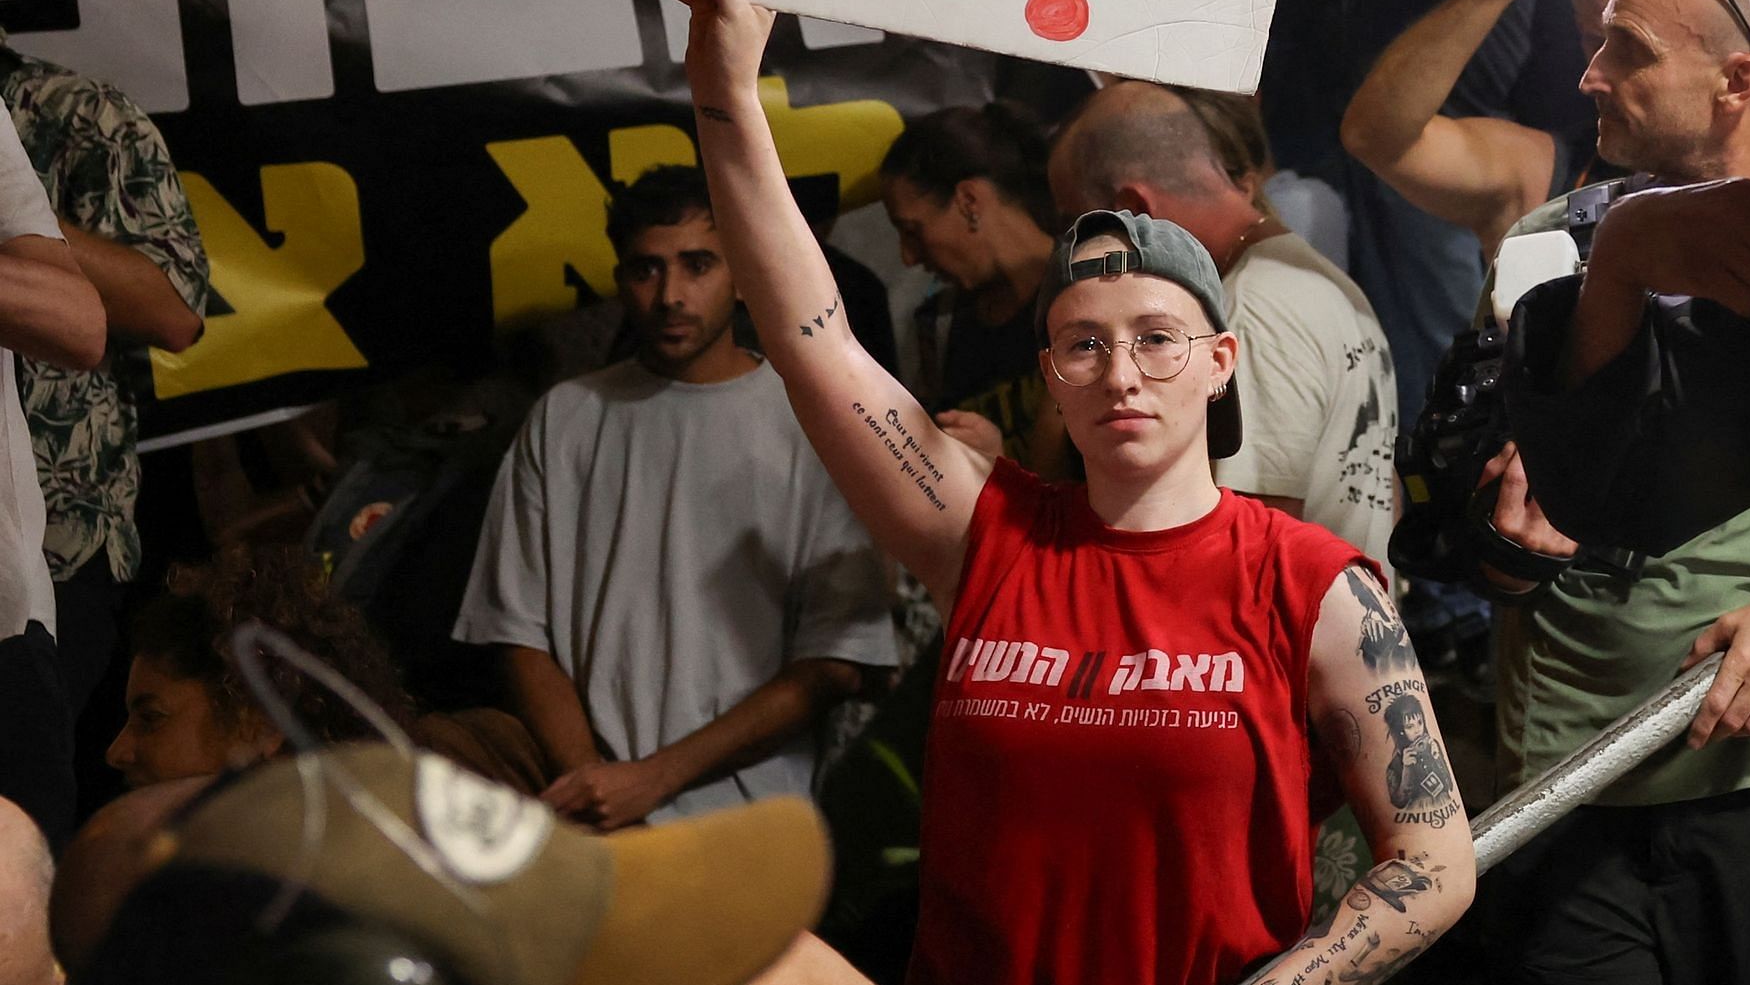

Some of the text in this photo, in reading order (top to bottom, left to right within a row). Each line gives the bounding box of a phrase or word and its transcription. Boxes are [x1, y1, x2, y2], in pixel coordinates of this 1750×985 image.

[864, 415, 887, 438] sont
[900, 460, 919, 477] qui
[902, 436, 921, 453] qui
[1108, 649, 1245, 696] מאבק
[1365, 679, 1427, 714] STRANGE
[1023, 701, 1051, 721] לא
[1053, 704, 1114, 726] הנשים,
[1118, 707, 1181, 728] בזכויות
[1186, 709, 1239, 729] פגיעה
[1393, 799, 1461, 829] UNUSUAL
